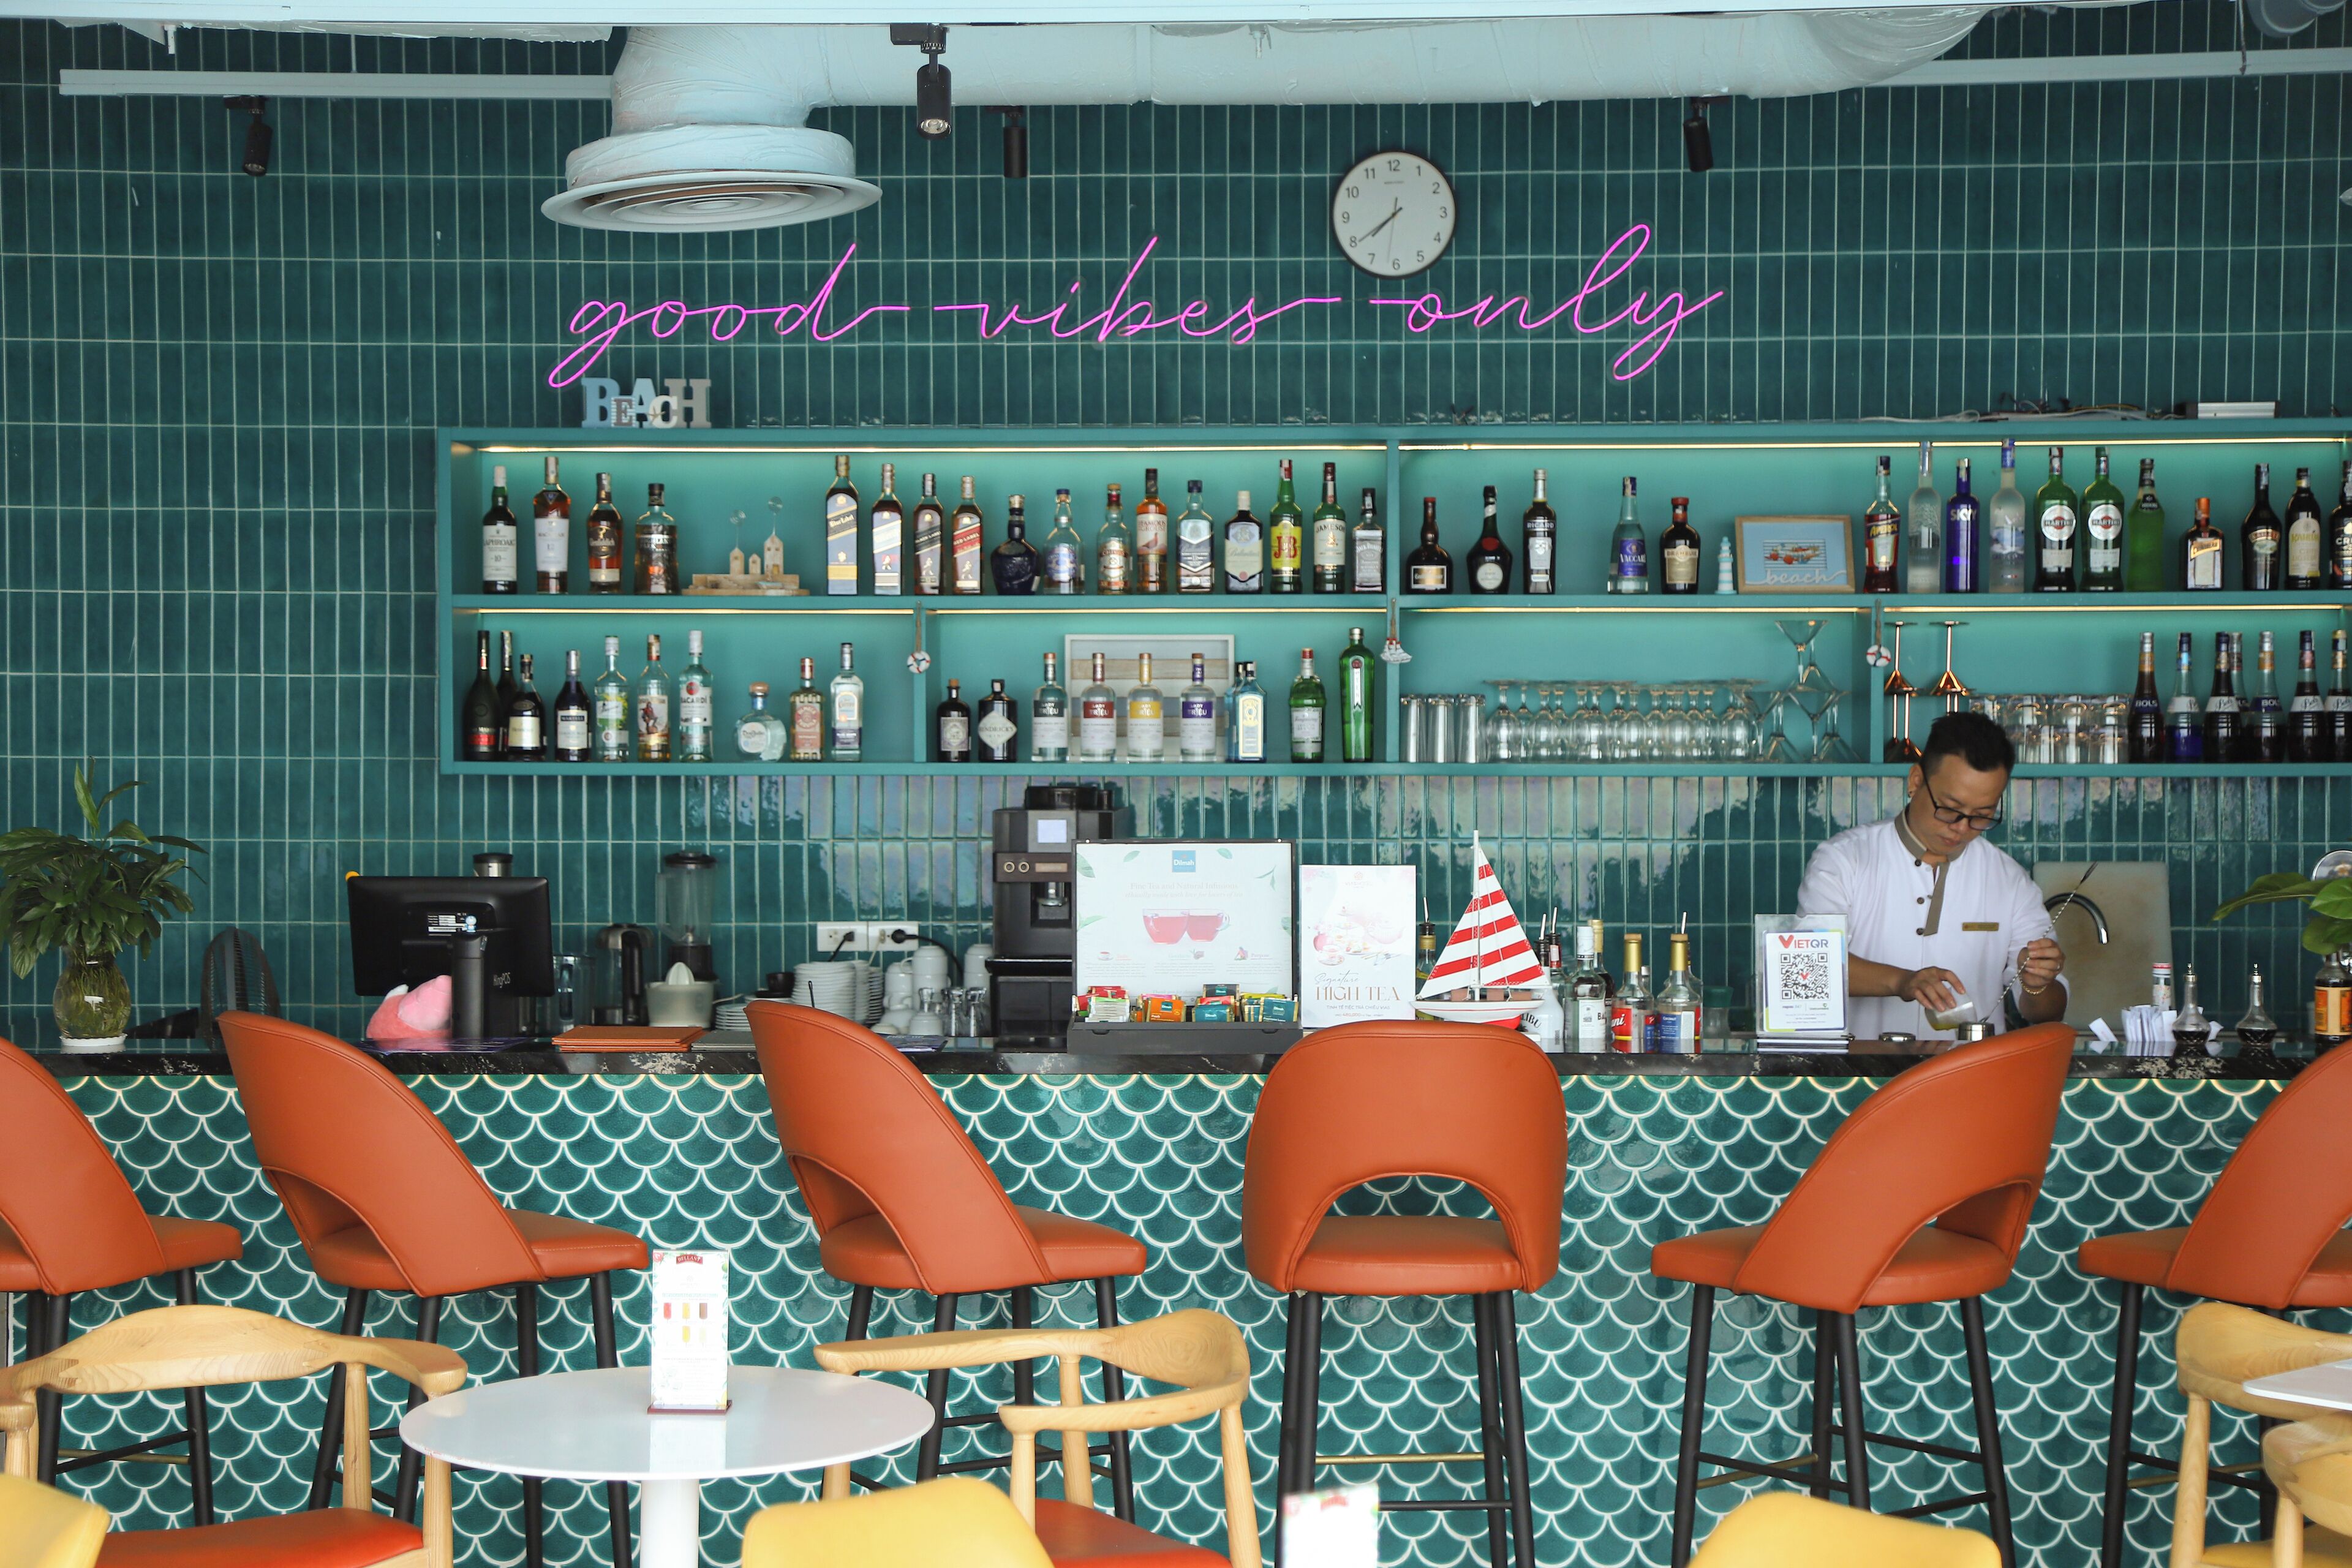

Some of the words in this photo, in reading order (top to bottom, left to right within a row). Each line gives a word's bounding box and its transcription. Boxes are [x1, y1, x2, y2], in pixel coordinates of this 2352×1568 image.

[1387, 159, 1400, 172] 12
[1415, 165, 1421, 176] 1
[1364, 168, 1376, 179] 11
[1346, 186, 1359, 198] 10
[1432, 182, 1440, 194] 2
[1342, 211, 1350, 224] 9
[1439, 206, 1447, 218] 3
[1349, 236, 1357, 247] 8
[1433, 232, 1441, 243] 4
[1368, 253, 1376, 265] 7
[1416, 251, 1425, 262] 5
[1392, 258, 1401, 270] 6
[548, 243, 911, 388] good
[934, 238, 1340, 344] vibes
[1371, 224, 1723, 381] only
[581, 377, 712, 428] BEACH
[1316, 524, 1346, 533] JAMESON
[1746, 568, 1846, 586] beach
[1778, 935, 1828, 949] VIETQR
[1314, 970, 1359, 989] Signature
[1316, 987, 1359, 1000] HIGH
[1365, 987, 1401, 1000] TEA
[1521, 1012, 1542, 1028] LIBU
